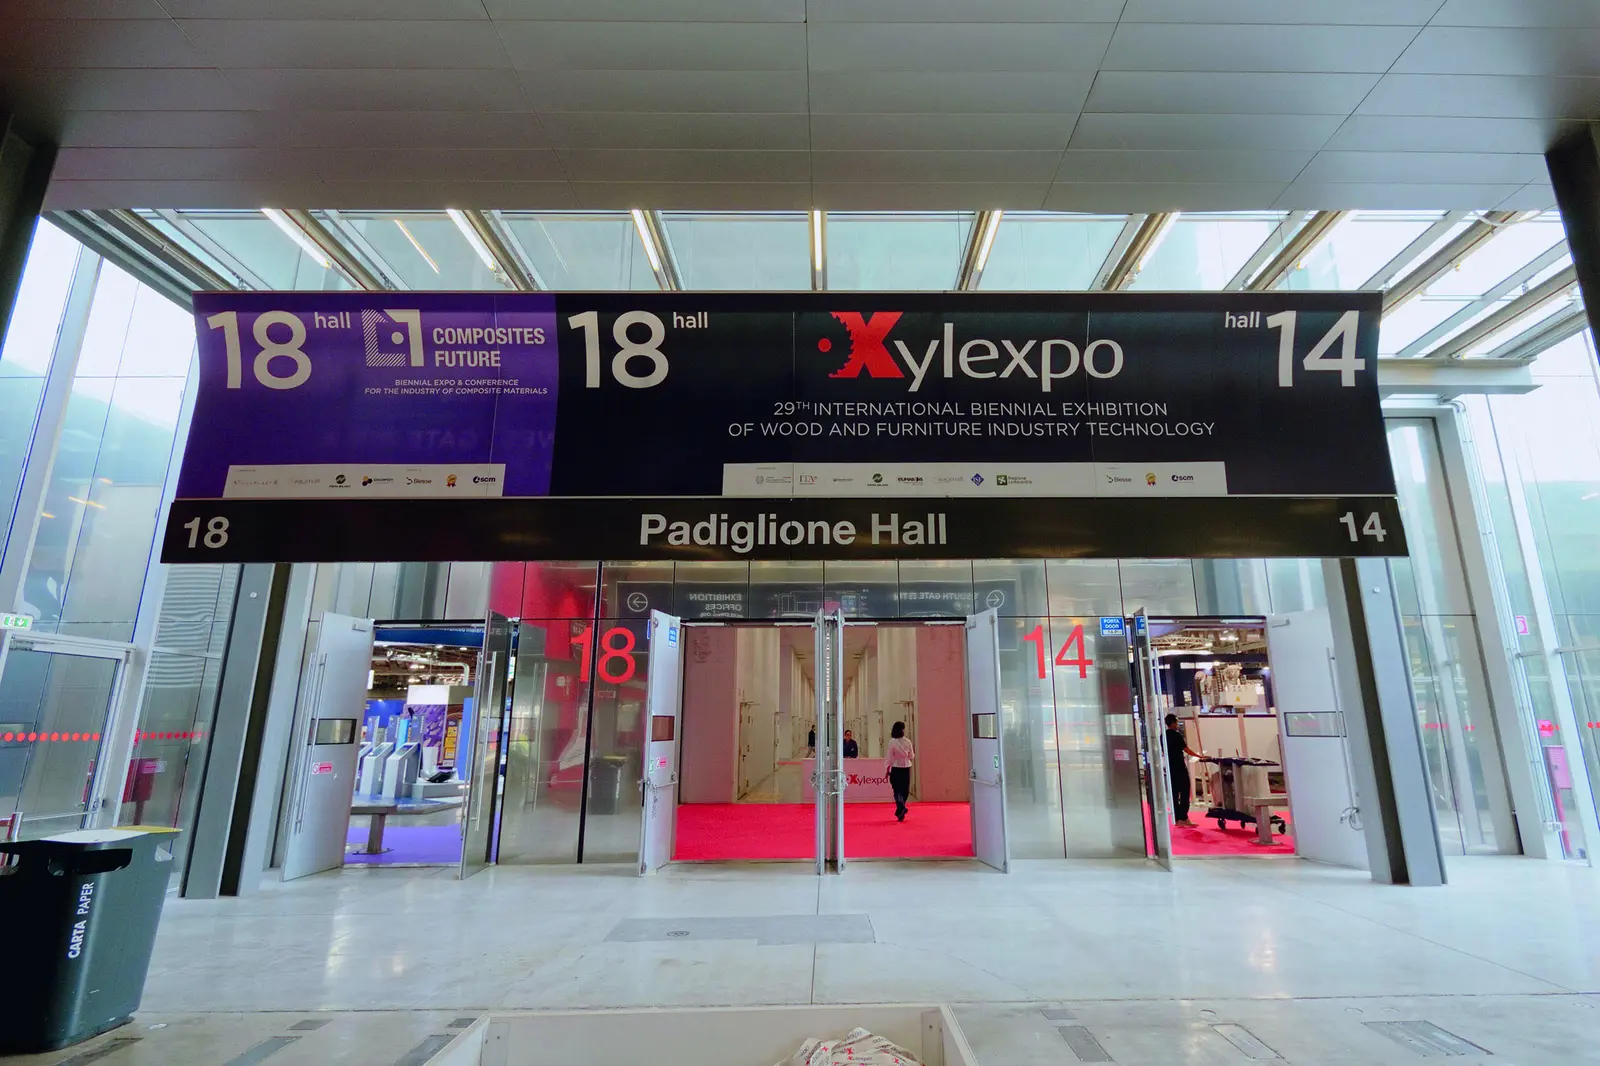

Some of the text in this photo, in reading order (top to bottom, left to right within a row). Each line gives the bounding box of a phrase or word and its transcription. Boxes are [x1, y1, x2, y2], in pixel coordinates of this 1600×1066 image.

[206, 310, 351, 390] 18 hall
[432, 327, 546, 345] COMPOSITES
[568, 310, 708, 389] 18 hall
[828, 311, 1124, 393] Xylexpo
[1224, 310, 1366, 388] hall 14
[434, 350, 502, 368] FUTURE
[364, 387, 548, 395] FOR THE INDUSTRY OF COMPOSITE MATERIALS
[773, 401, 1168, 416] 29TH INTERNATIONAL BIENNIAL EXHIBITION
[728, 422, 1215, 437] OF WOOD AND FURNITURE INDUSTRY TECHNOLOGY
[183, 516, 230, 549] 18
[639, 513, 947, 554] Padiglione Hall
[1339, 511, 1387, 543] 14
[570, 627, 636, 685] 18
[1022, 624, 1094, 680] 14
[848, 774, 889, 786] Xylexpo
[68, 881, 95, 959] CARTA PAPER
